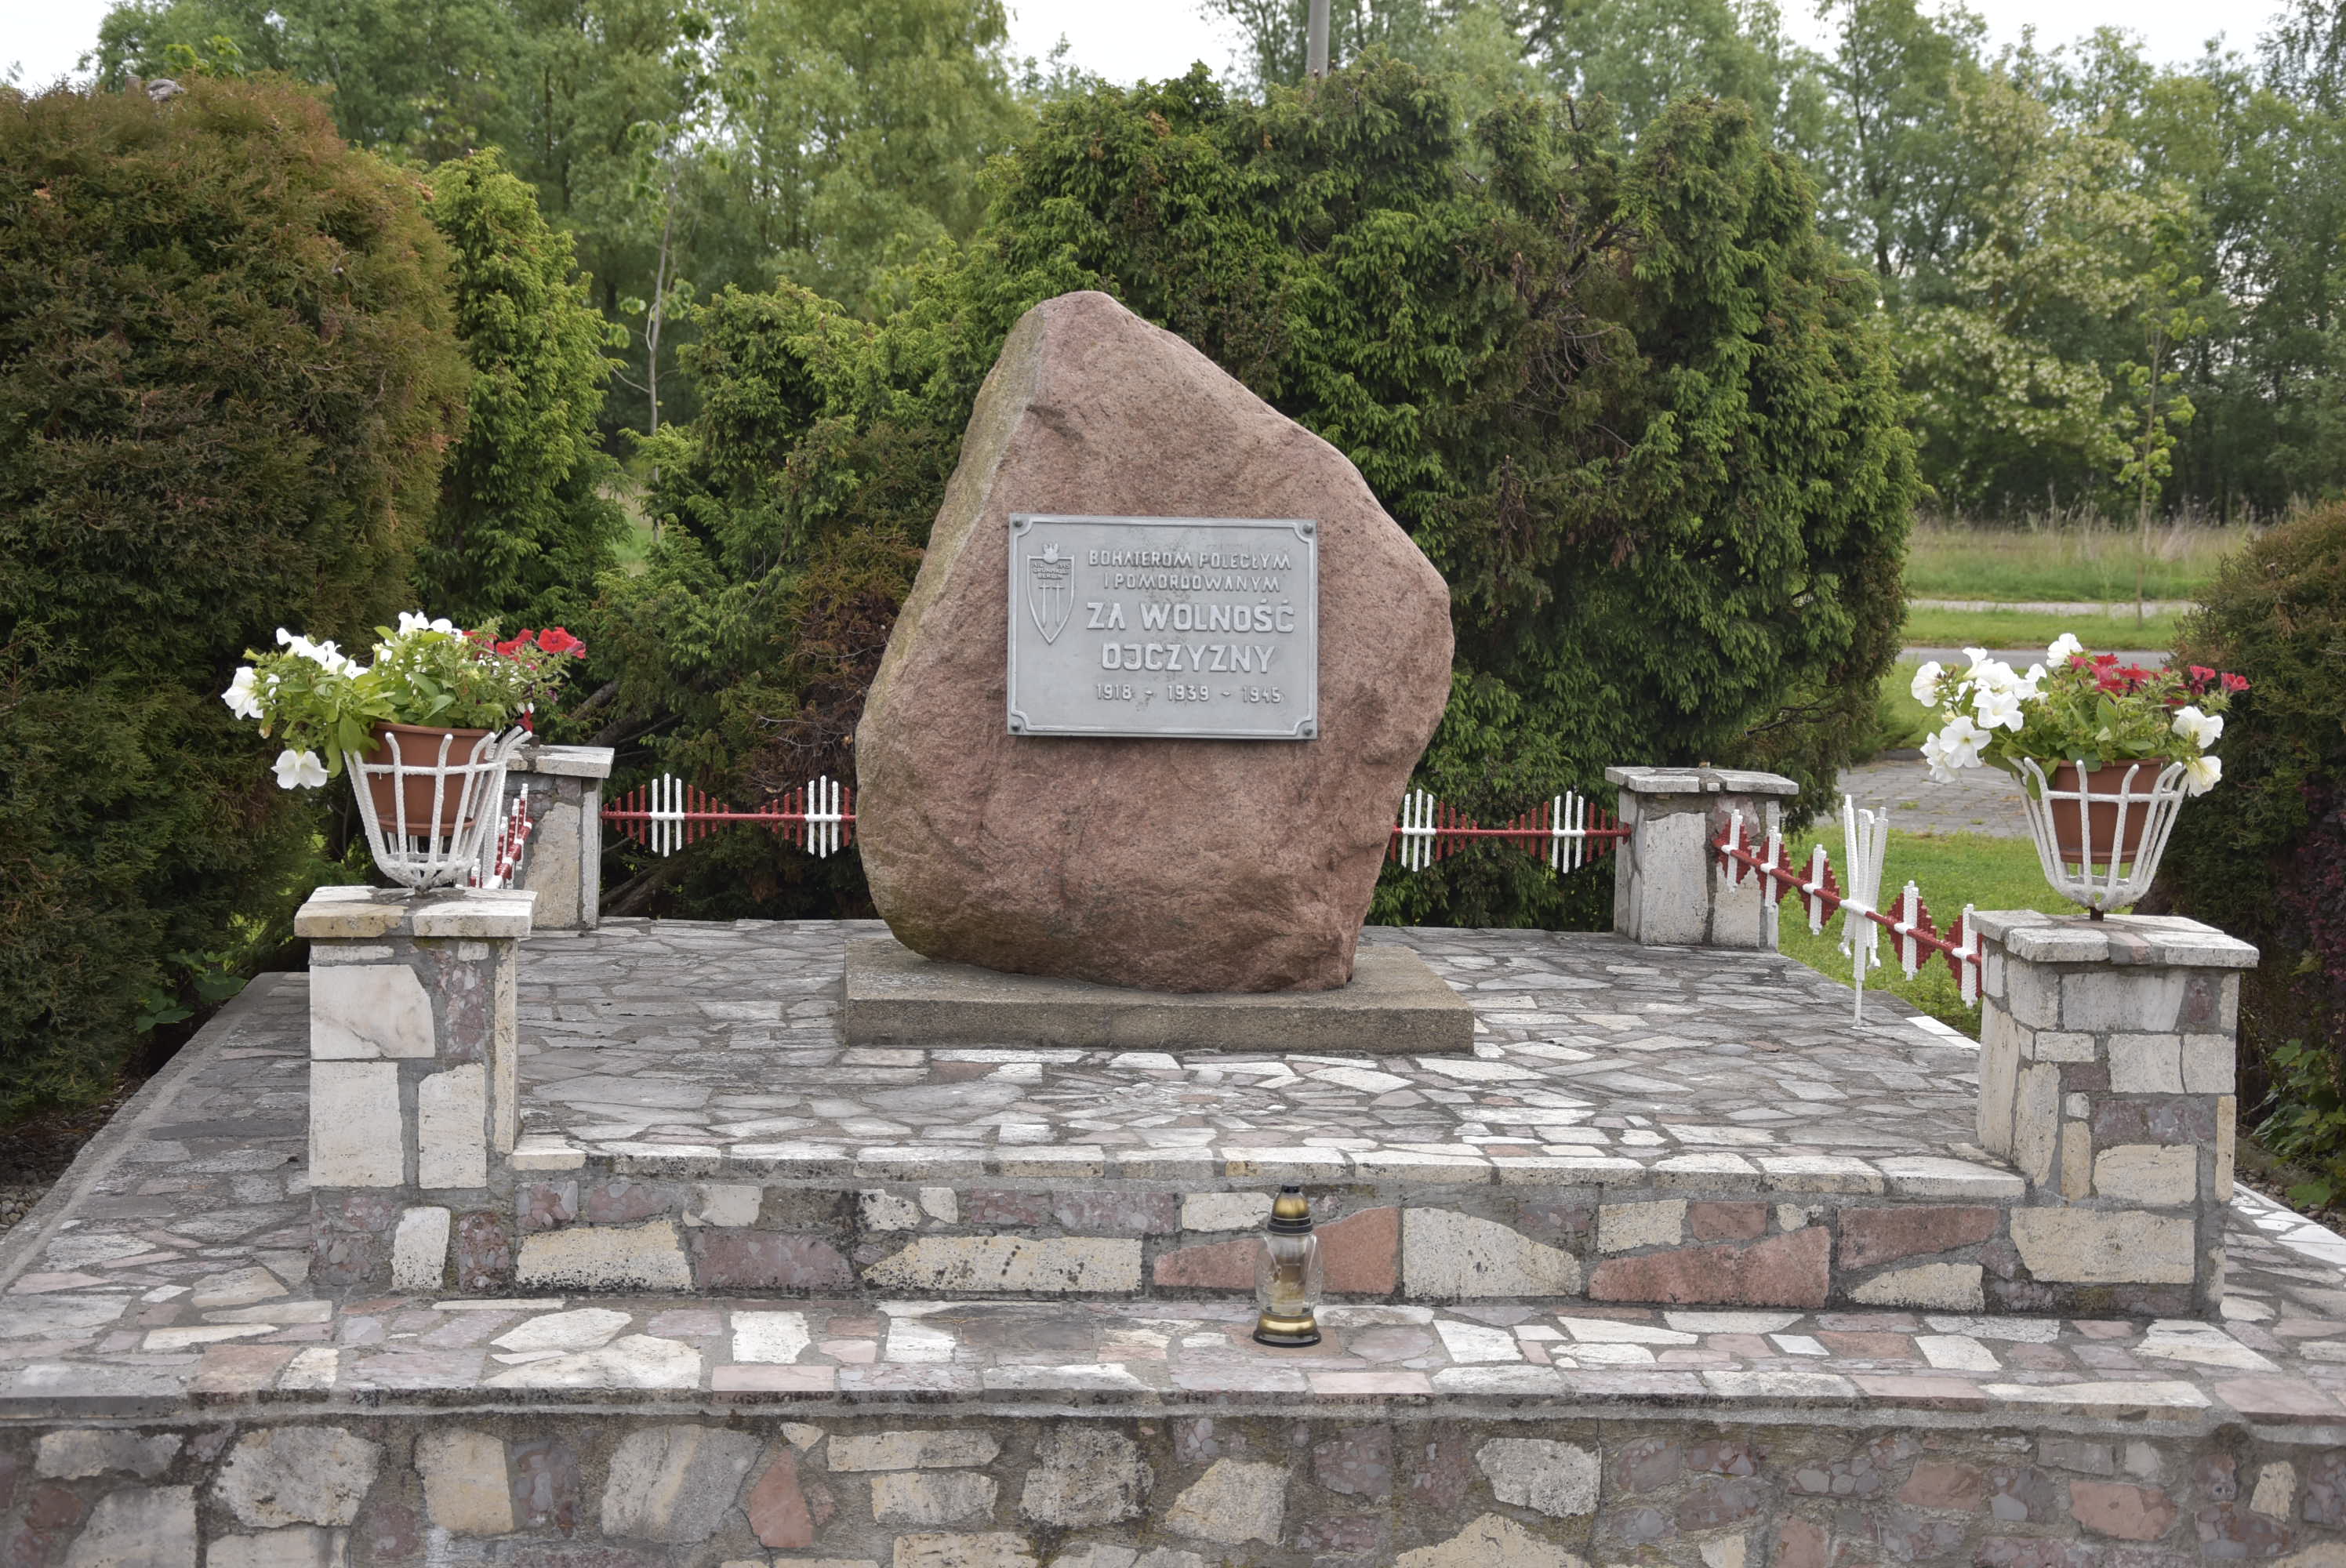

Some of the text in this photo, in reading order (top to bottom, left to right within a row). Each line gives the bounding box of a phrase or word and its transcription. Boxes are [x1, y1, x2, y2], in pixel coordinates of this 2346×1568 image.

[1088, 550, 1193, 568] BOHATEROM
[1104, 572, 1280, 593] I POMORDOWANYM
[1087, 598, 1294, 633] ZA WOLNOŚĆ
[1102, 643, 1275, 673] OJCZYZNY
[1097, 684, 1132, 701] 1918
[1167, 684, 1210, 702] 1939
[1242, 687, 1281, 703] 1945
